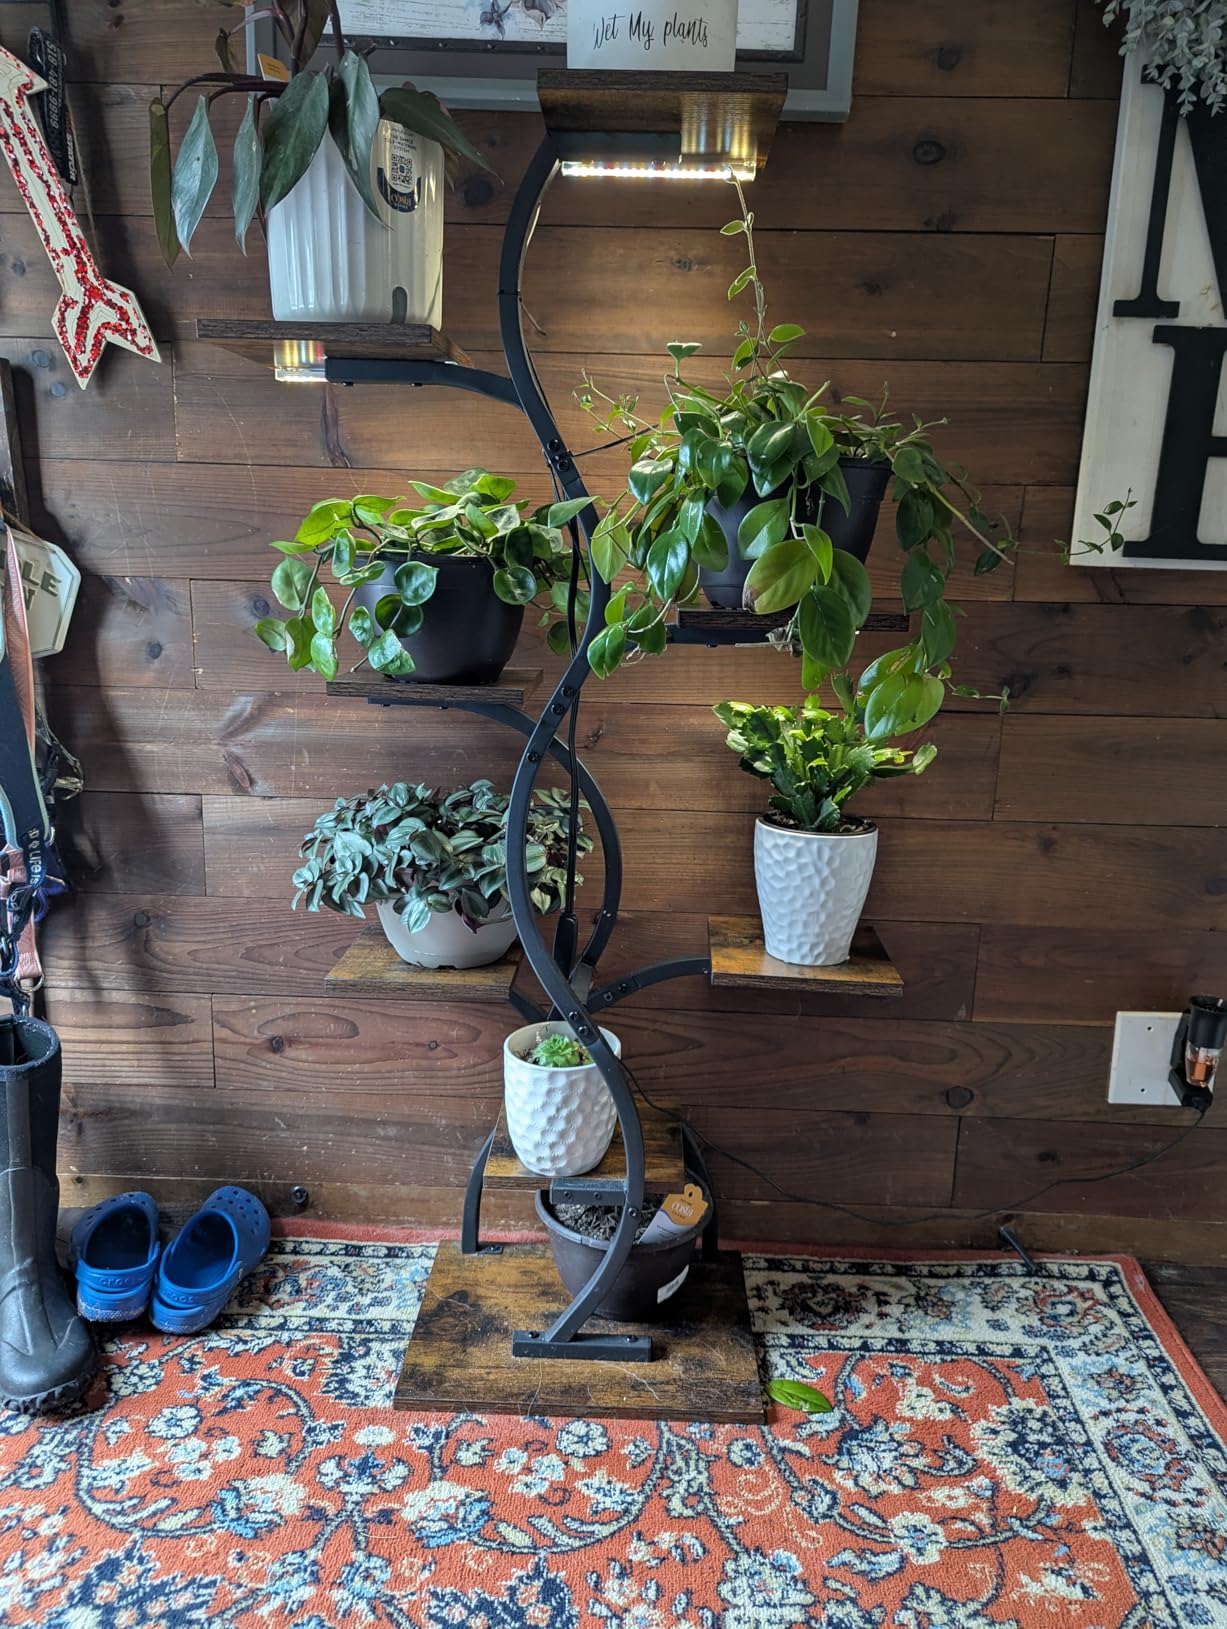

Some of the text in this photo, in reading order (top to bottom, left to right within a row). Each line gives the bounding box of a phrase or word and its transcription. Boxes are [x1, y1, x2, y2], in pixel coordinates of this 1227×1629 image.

[629, 11, 655, 51] My
[664, 12, 709, 48] plants
[46, 40, 59, 129] 518-481-9999
